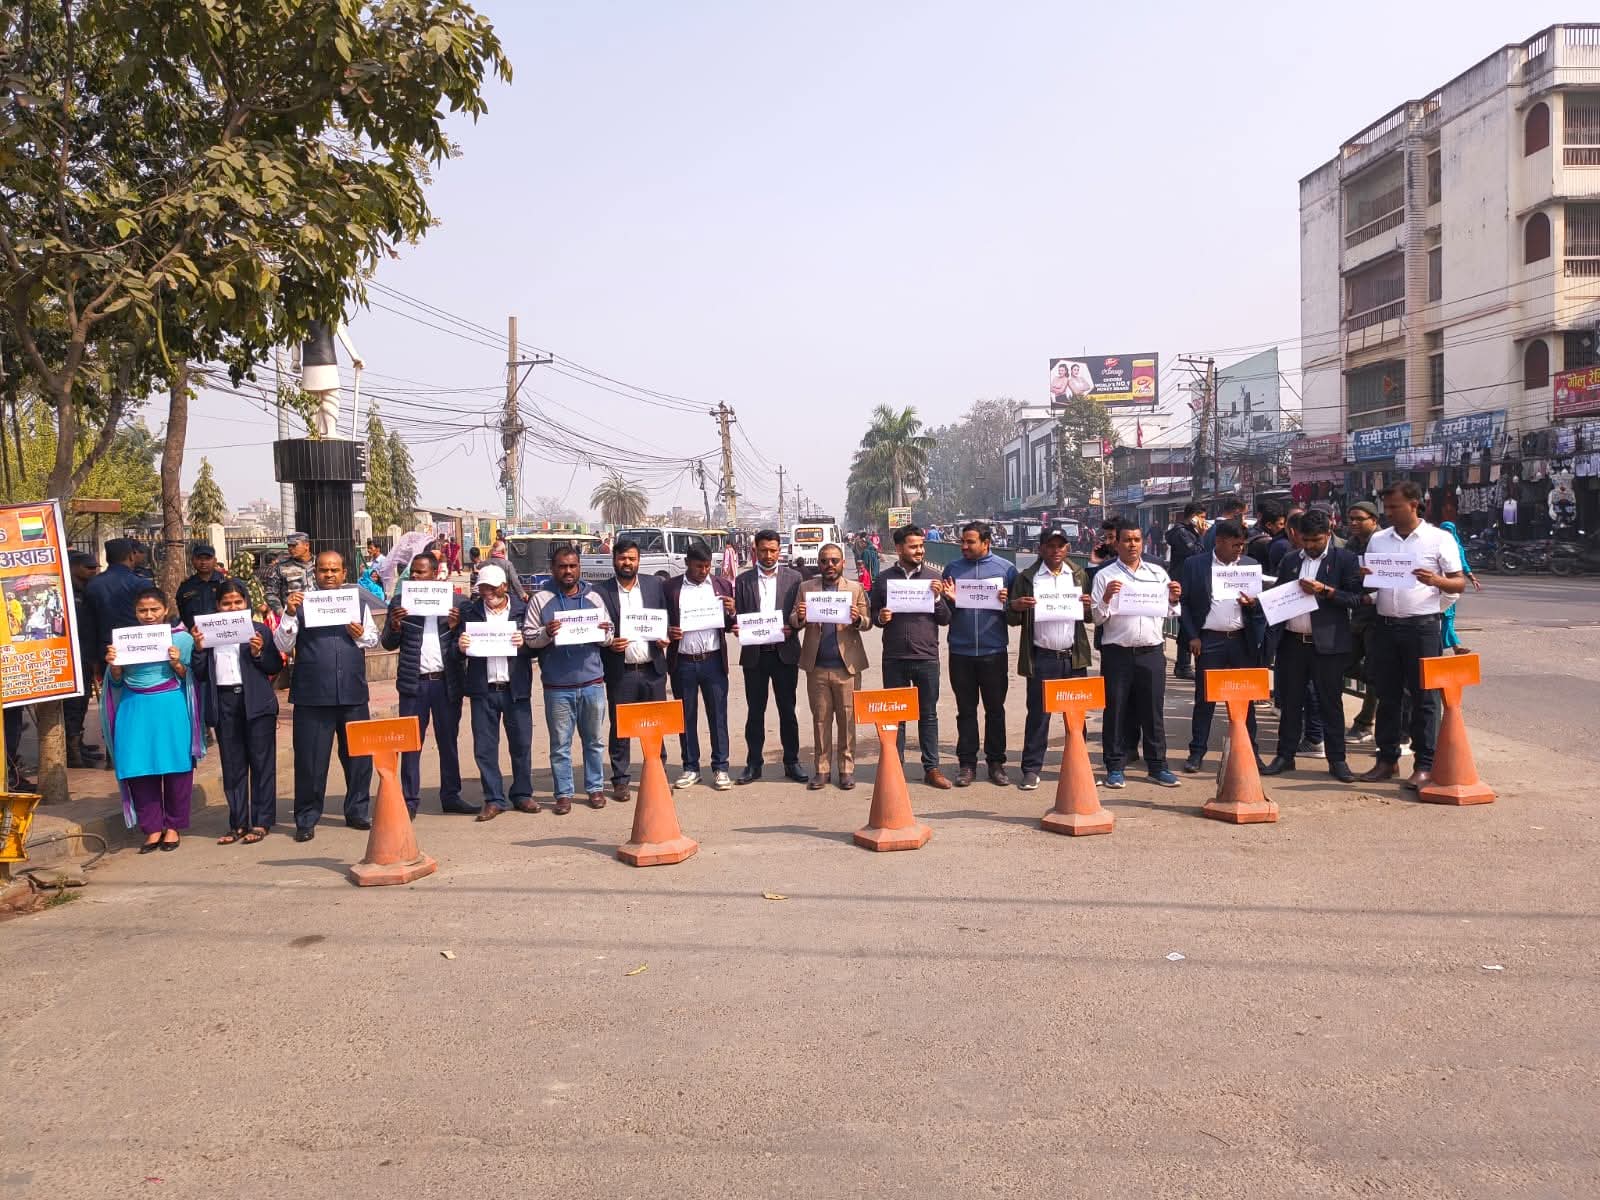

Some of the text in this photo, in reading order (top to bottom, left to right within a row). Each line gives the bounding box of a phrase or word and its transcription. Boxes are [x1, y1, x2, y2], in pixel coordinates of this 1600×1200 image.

[581, 571, 614, 579] Mahindr
[1056, 690, 1092, 701] Hilltake
[868, 701, 907, 712] Hilltake
